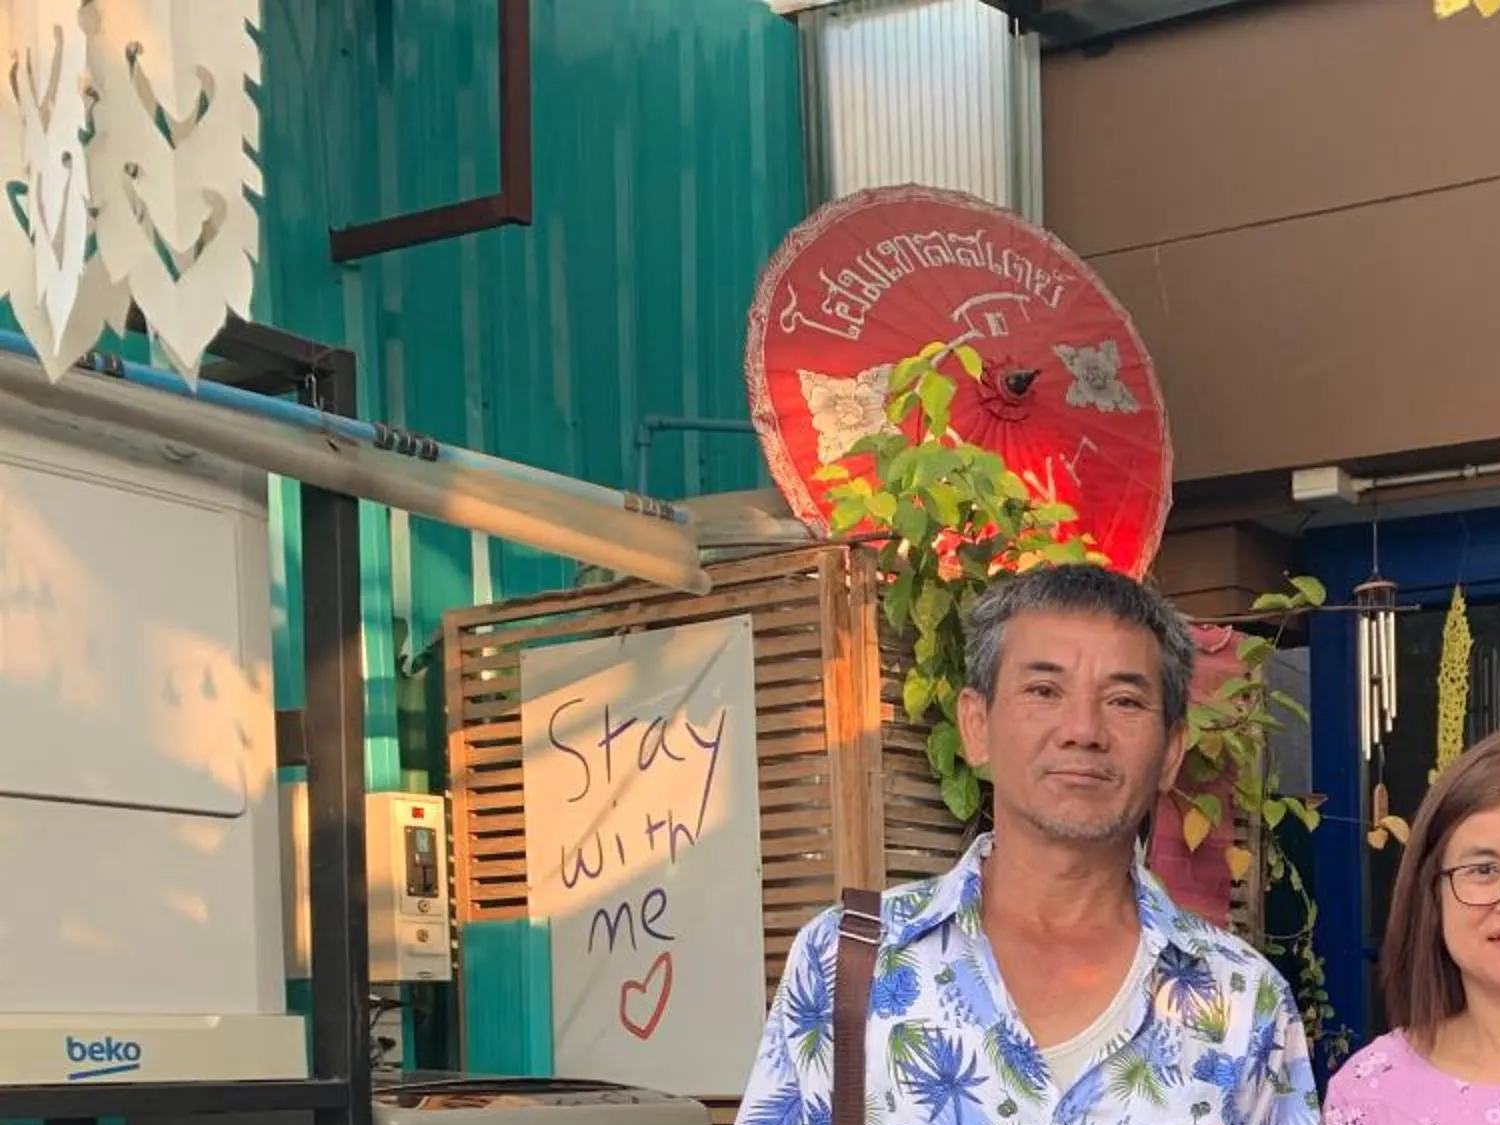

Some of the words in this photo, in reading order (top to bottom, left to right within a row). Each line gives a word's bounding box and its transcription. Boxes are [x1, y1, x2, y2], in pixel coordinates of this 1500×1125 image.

[548, 698, 726, 838] Stay
[561, 810, 697, 890] with
[587, 887, 675, 954] me
[66, 1036, 142, 1062] beko
